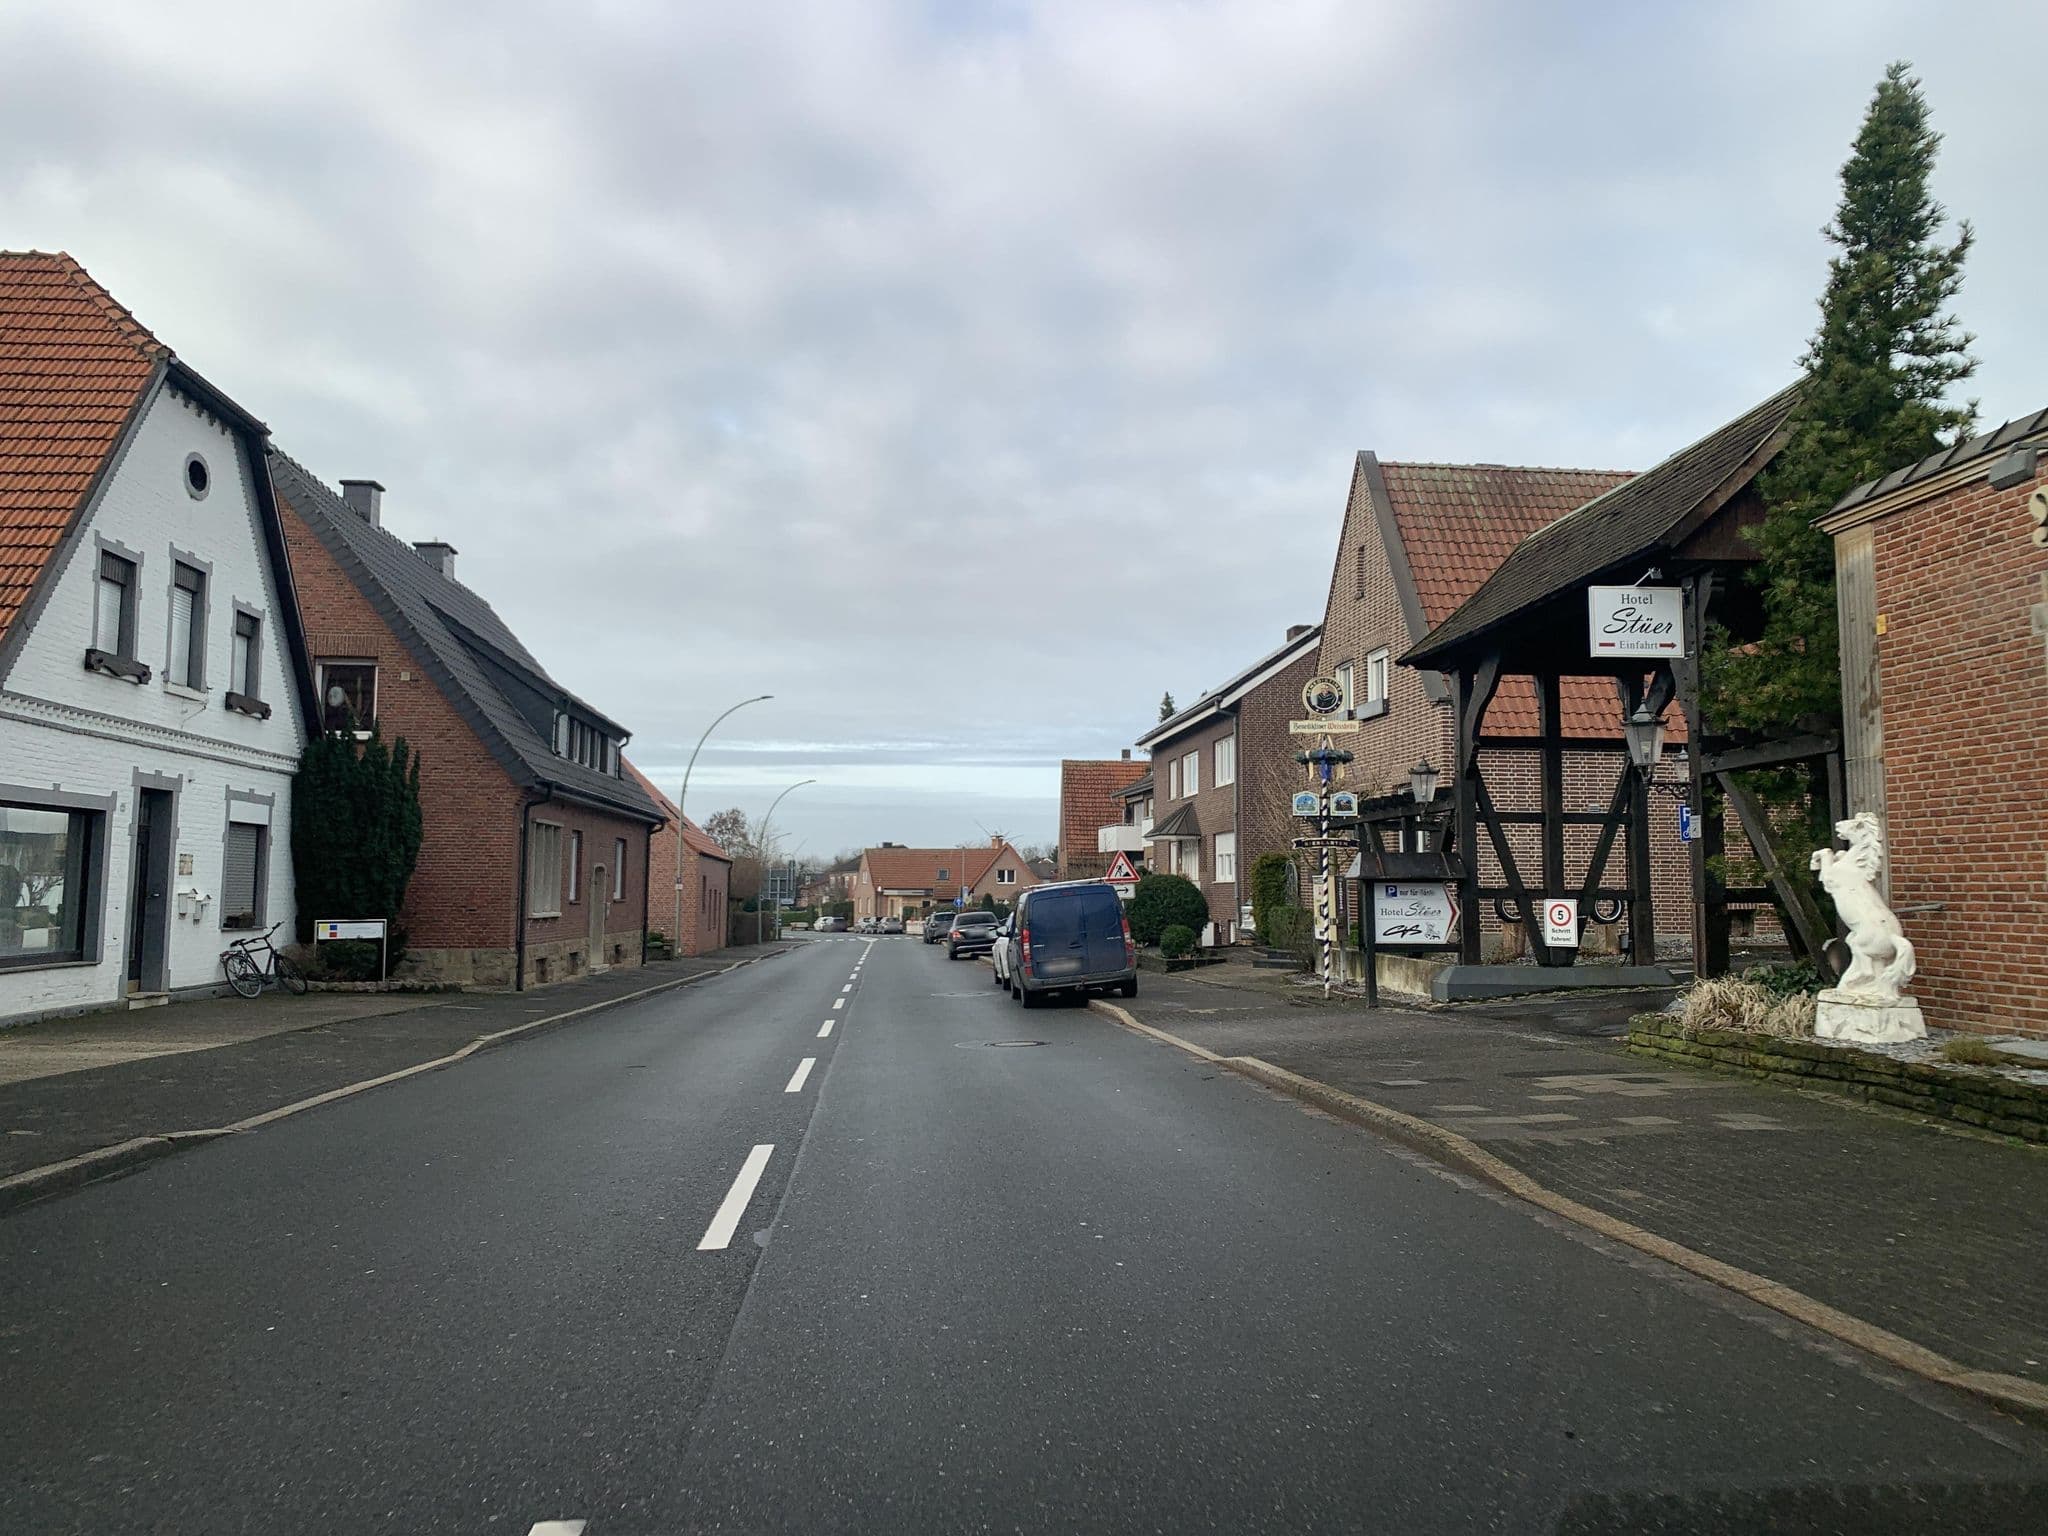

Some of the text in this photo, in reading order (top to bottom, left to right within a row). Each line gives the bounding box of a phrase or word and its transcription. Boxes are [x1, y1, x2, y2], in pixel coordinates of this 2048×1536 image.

[1621, 594, 1653, 605] Hotel
[1603, 607, 1673, 634] Stüer
[1619, 640, 1658, 649] Einfahrt
[1381, 908, 1403, 916] Hotel
[1557, 910, 1564, 920] 5
